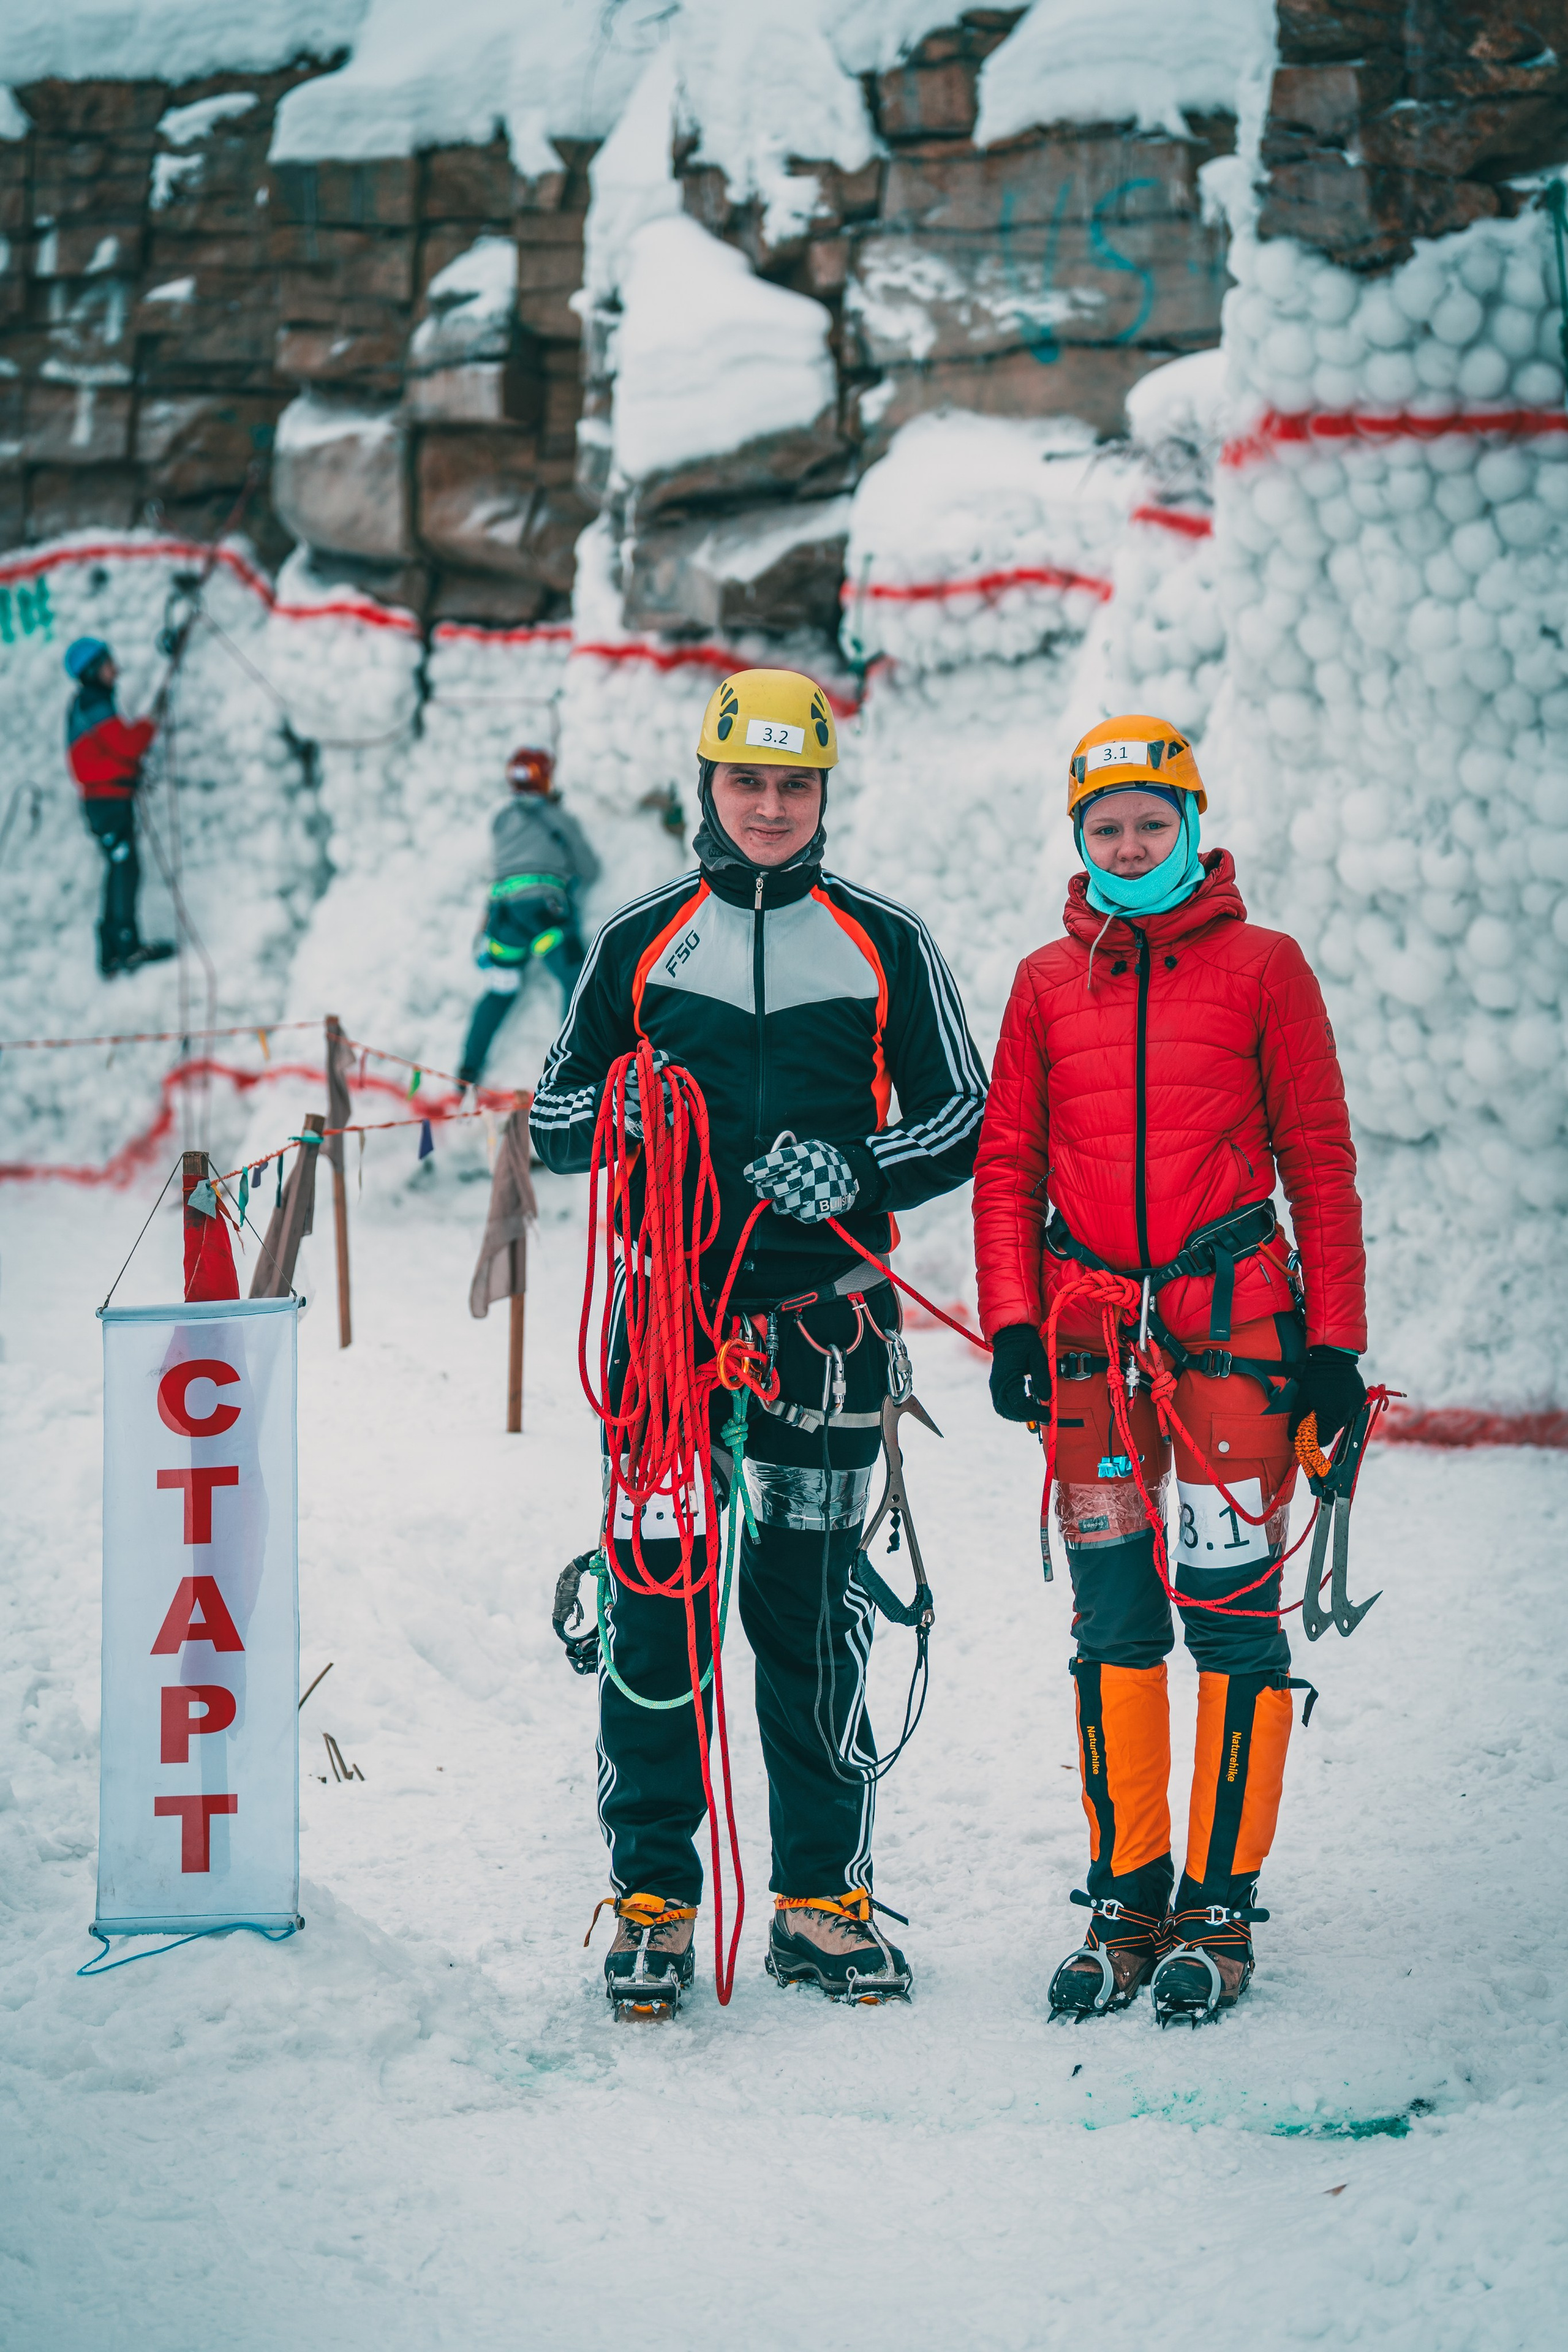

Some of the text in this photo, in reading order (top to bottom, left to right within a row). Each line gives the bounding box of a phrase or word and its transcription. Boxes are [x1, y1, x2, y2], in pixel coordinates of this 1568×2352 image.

[763, 727, 789, 745] 3.2
[1103, 746, 1128, 761] 3.1
[1183, 1502, 1250, 1551] 3.1
[150, 1359, 246, 1874] СТАРТ
[1087, 1725, 1100, 1775] Naturehike
[1227, 1731, 1242, 1782] Naturehike
